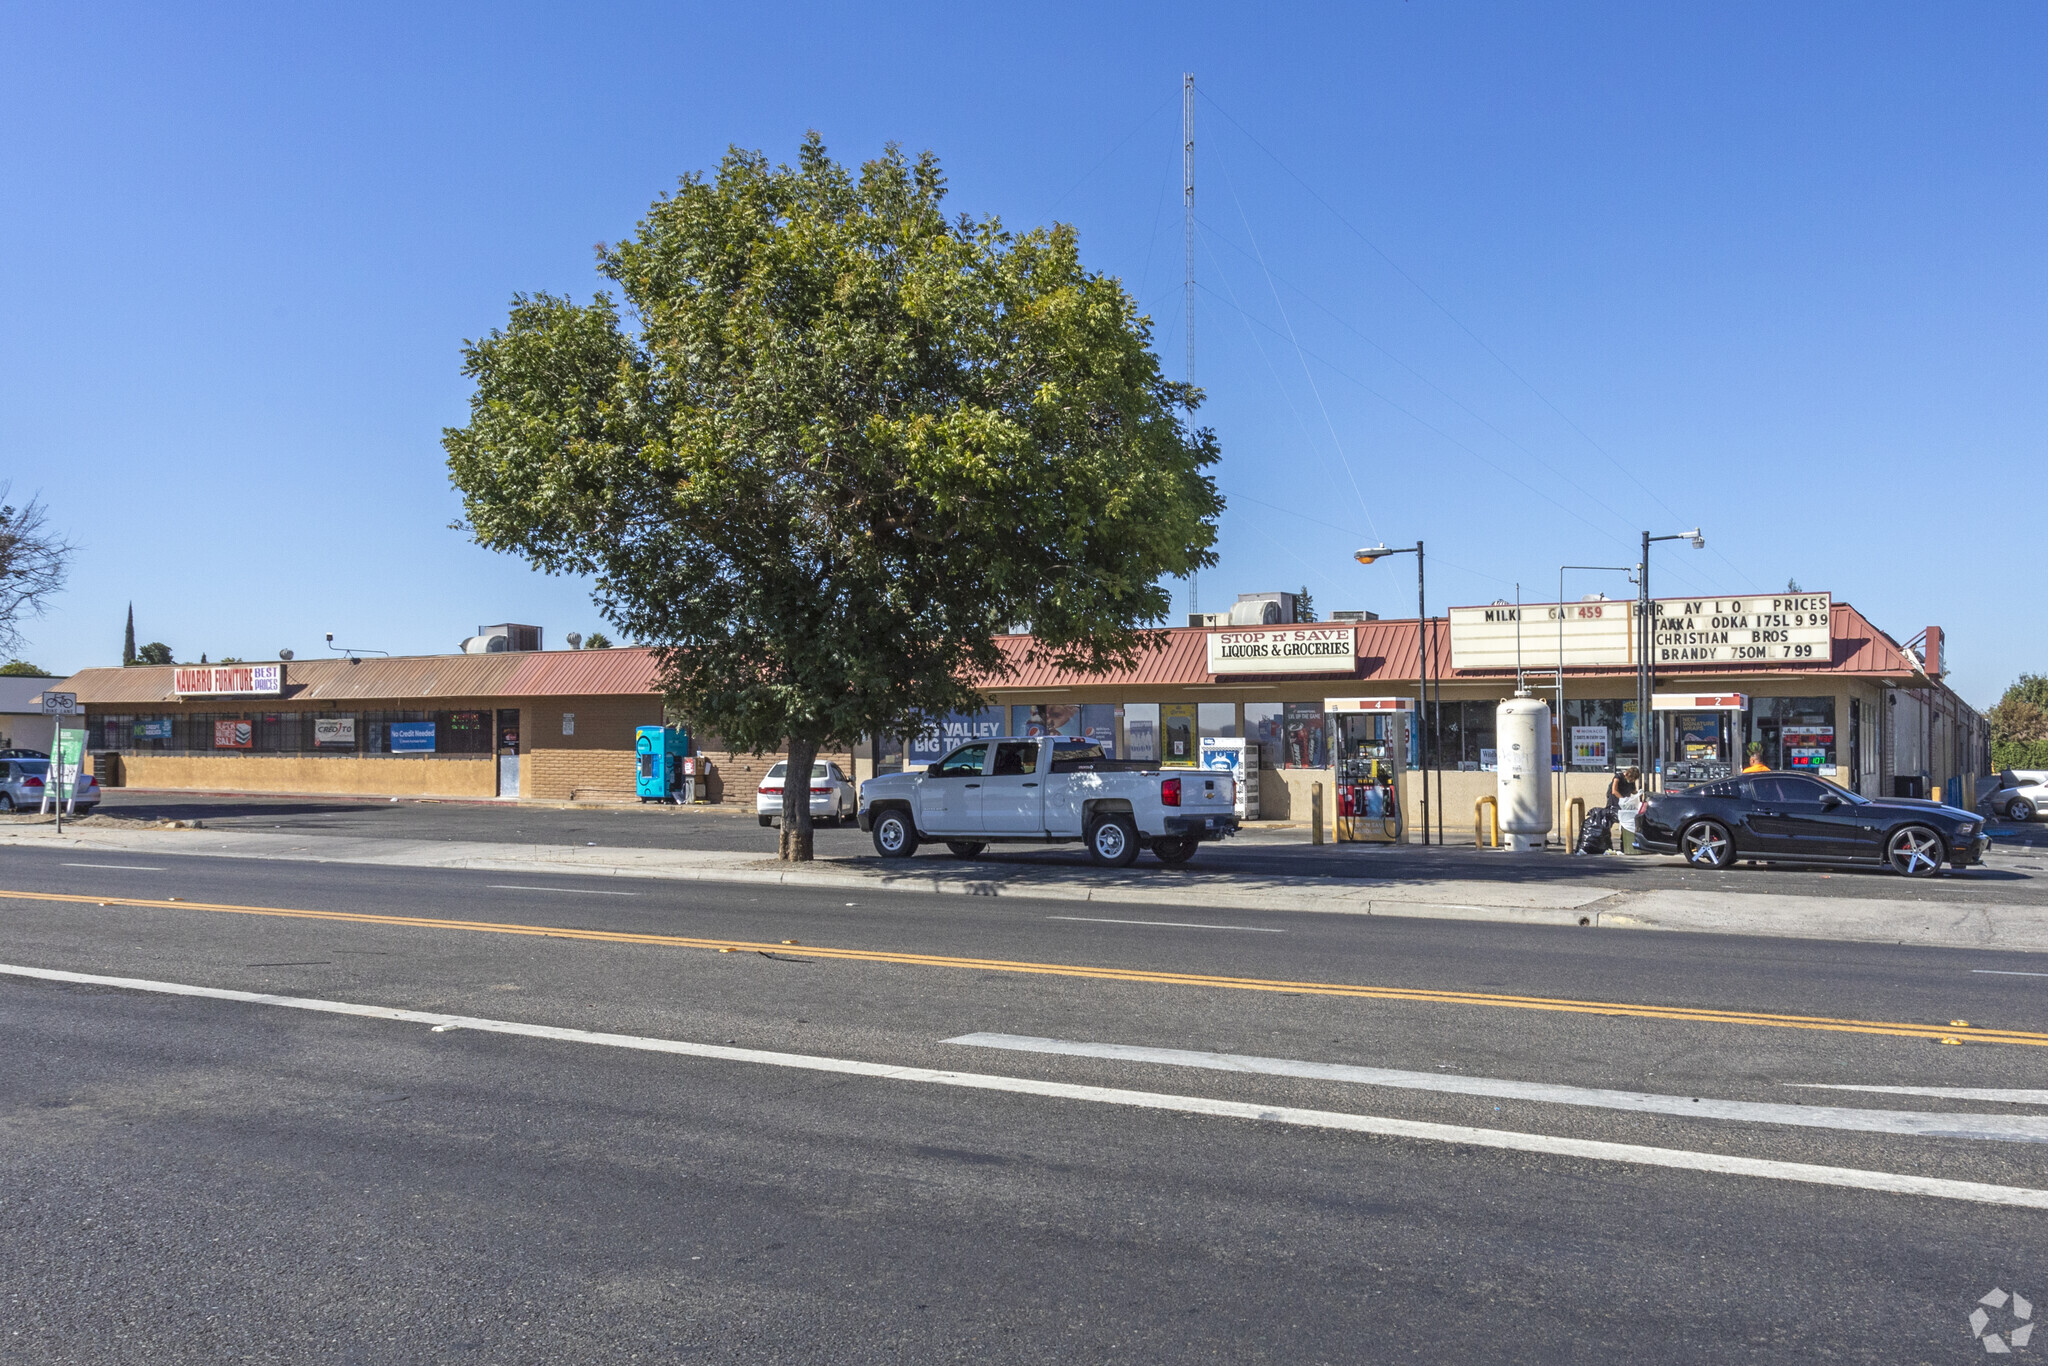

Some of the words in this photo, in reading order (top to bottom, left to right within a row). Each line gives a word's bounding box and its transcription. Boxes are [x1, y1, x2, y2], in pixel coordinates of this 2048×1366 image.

[1773, 598, 1827, 611] PRICES
[1578, 606, 1602, 619] 459
[1221, 632, 1265, 644] STOP
[1294, 630, 1349, 641] SAVE
[1656, 631, 1728, 645] CHRISTIAN
[1752, 630, 1788, 642] BROS
[1222, 645, 1268, 658] LIQUORS
[1271, 644, 1281, 656] &
[1283, 642, 1350, 656] GROCERIES
[1662, 648, 1717, 660] BRANDY
[254, 667, 277, 678] BEST
[176, 669, 212, 692] NAVARRO
[215, 668, 253, 692] FURNITURE
[254, 679, 278, 691] PRICES
[1714, 697, 1722, 706] 2
[133, 725, 145, 736] NO
[392, 730, 400, 738] No
[400, 730, 415, 738] Credit
[415, 729, 435, 738] Needed
[943, 722, 1000, 737] VALLEY
[215, 738, 236, 746] SALE
[915, 738, 940, 752] BIG
